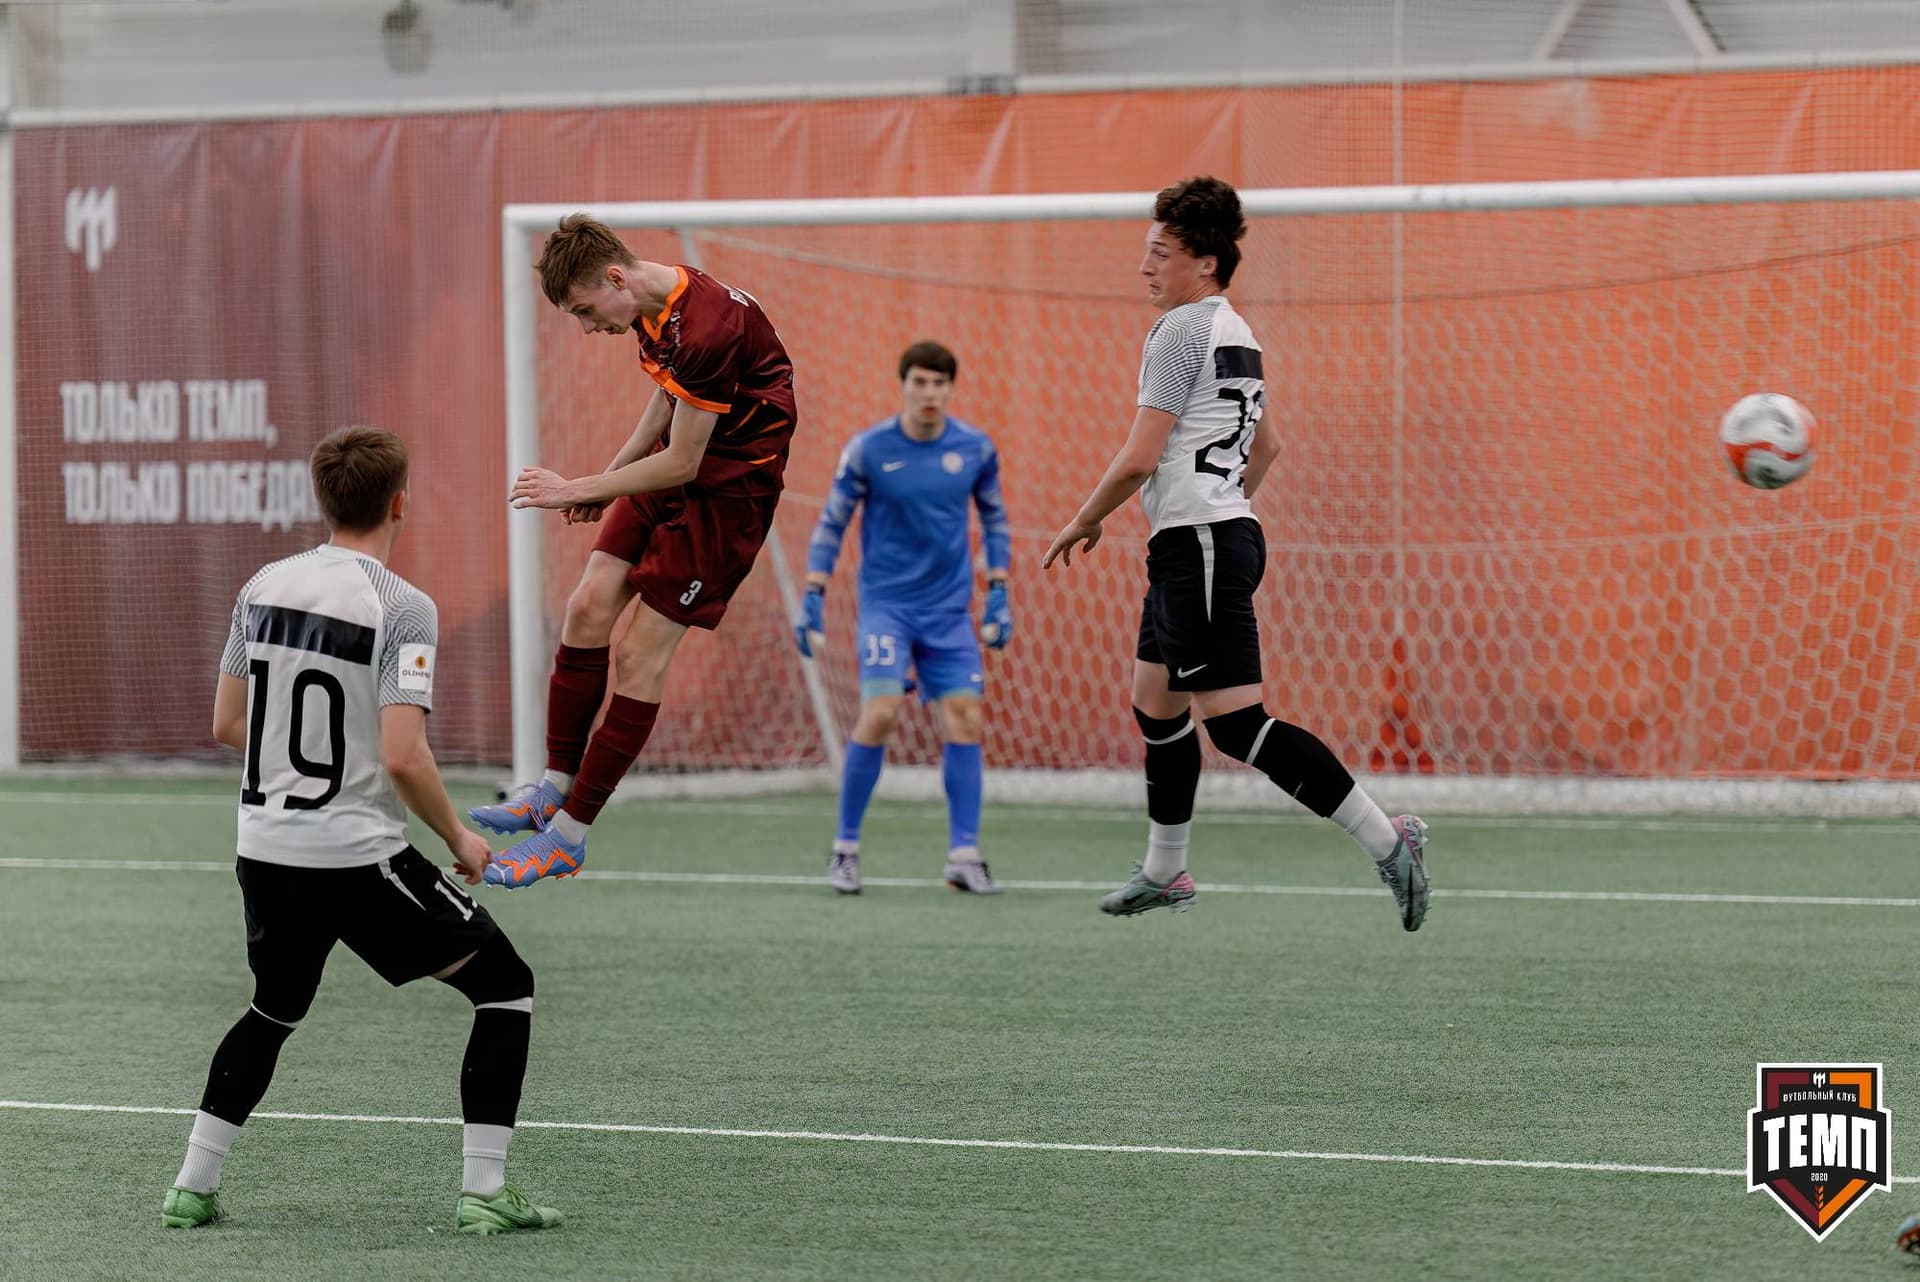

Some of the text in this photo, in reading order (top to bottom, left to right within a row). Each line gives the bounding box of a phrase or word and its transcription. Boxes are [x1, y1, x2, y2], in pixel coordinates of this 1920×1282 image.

[60, 378, 278, 449] ТОЛЬКО ТЕМП,
[63, 459, 181, 525] ТОЛЬКО
[679, 579, 703, 606] 3
[864, 633, 896, 666] 35
[242, 658, 346, 810] 19
